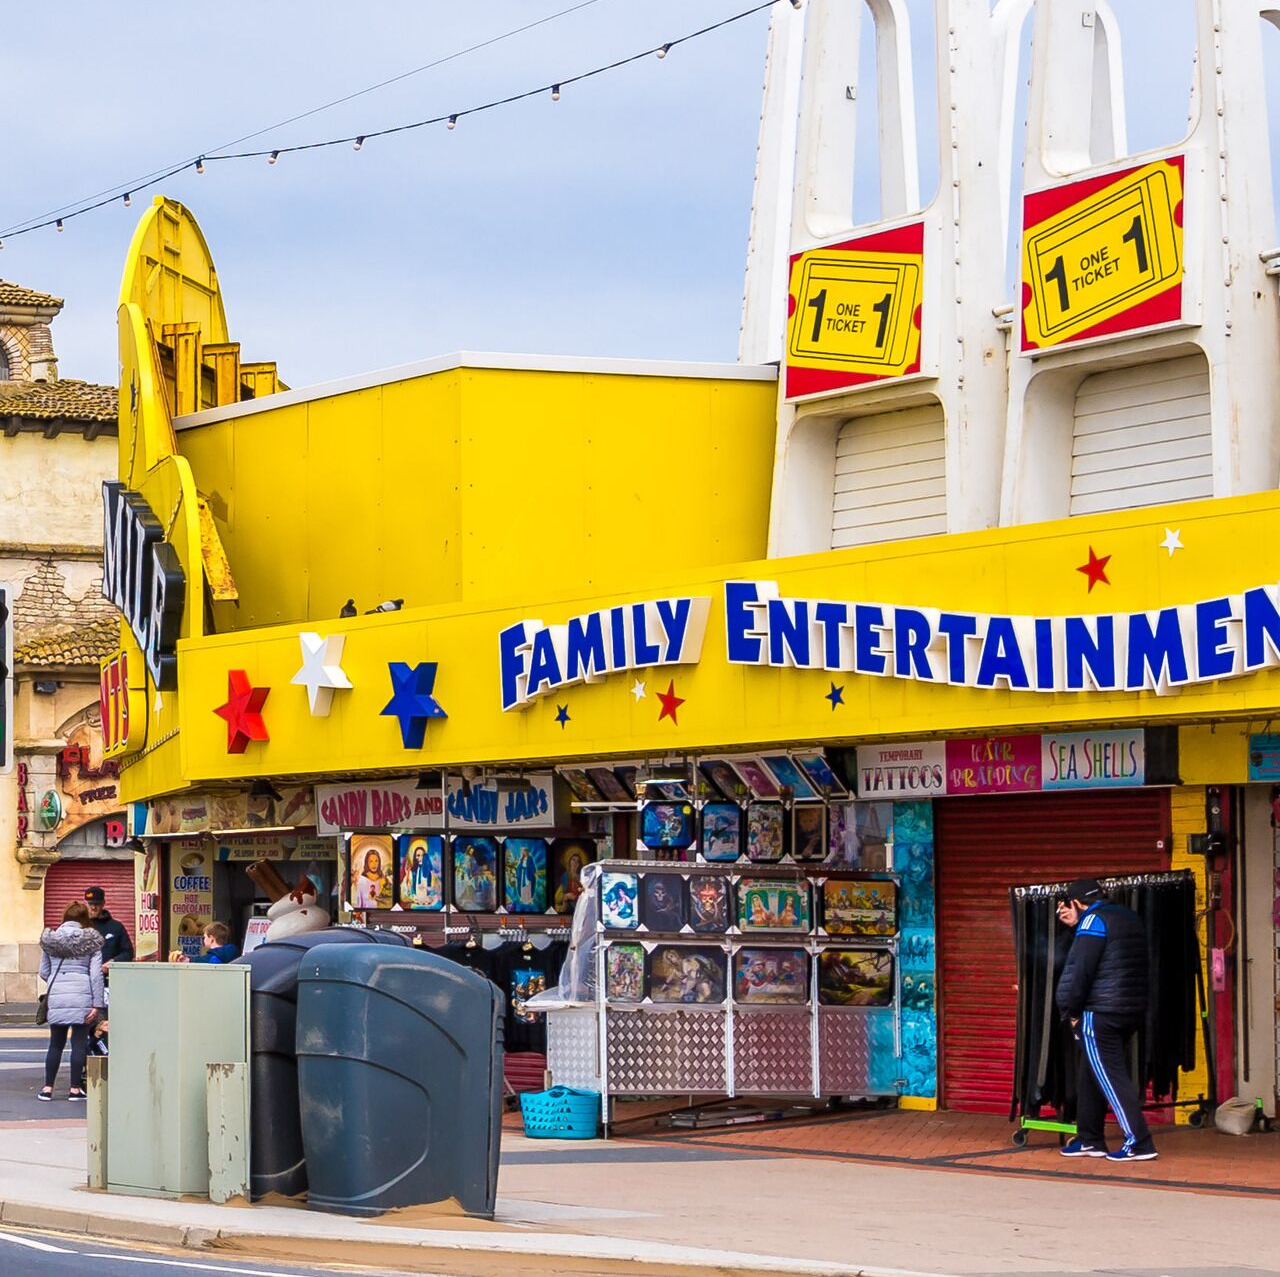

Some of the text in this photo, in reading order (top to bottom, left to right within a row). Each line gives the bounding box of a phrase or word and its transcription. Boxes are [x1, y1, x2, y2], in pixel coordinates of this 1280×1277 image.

[1122, 215, 1150, 274] 1
[1079, 246, 1110, 271] ONE
[1045, 255, 1072, 312] 1
[1072, 257, 1120, 291] TICKET
[808, 289, 827, 342] 1
[836, 303, 861, 317] ONE
[872, 293, 892, 348] 1
[826, 318, 866, 333] TICKET
[498, 580, 1280, 712] FAMILY ENTERTAINMEN
[879, 749, 923, 762] TEMPORARY
[971, 741, 1014, 763] HAIR
[1049, 738, 1137, 782] SEA SHELLS
[862, 764, 943, 792] TATTOOS
[952, 764, 1037, 789] BRAIDING
[17, 762, 28, 840] BAR
[321, 783, 548, 826] CANDY BARS AND CANDY JARS
[173, 876, 210, 890] COFFEE
[172, 904, 211, 914] CHOCOLATE
[184, 893, 199, 903] HOT
[139, 914, 158, 931] DOGS
[183, 946, 201, 955] MADE
